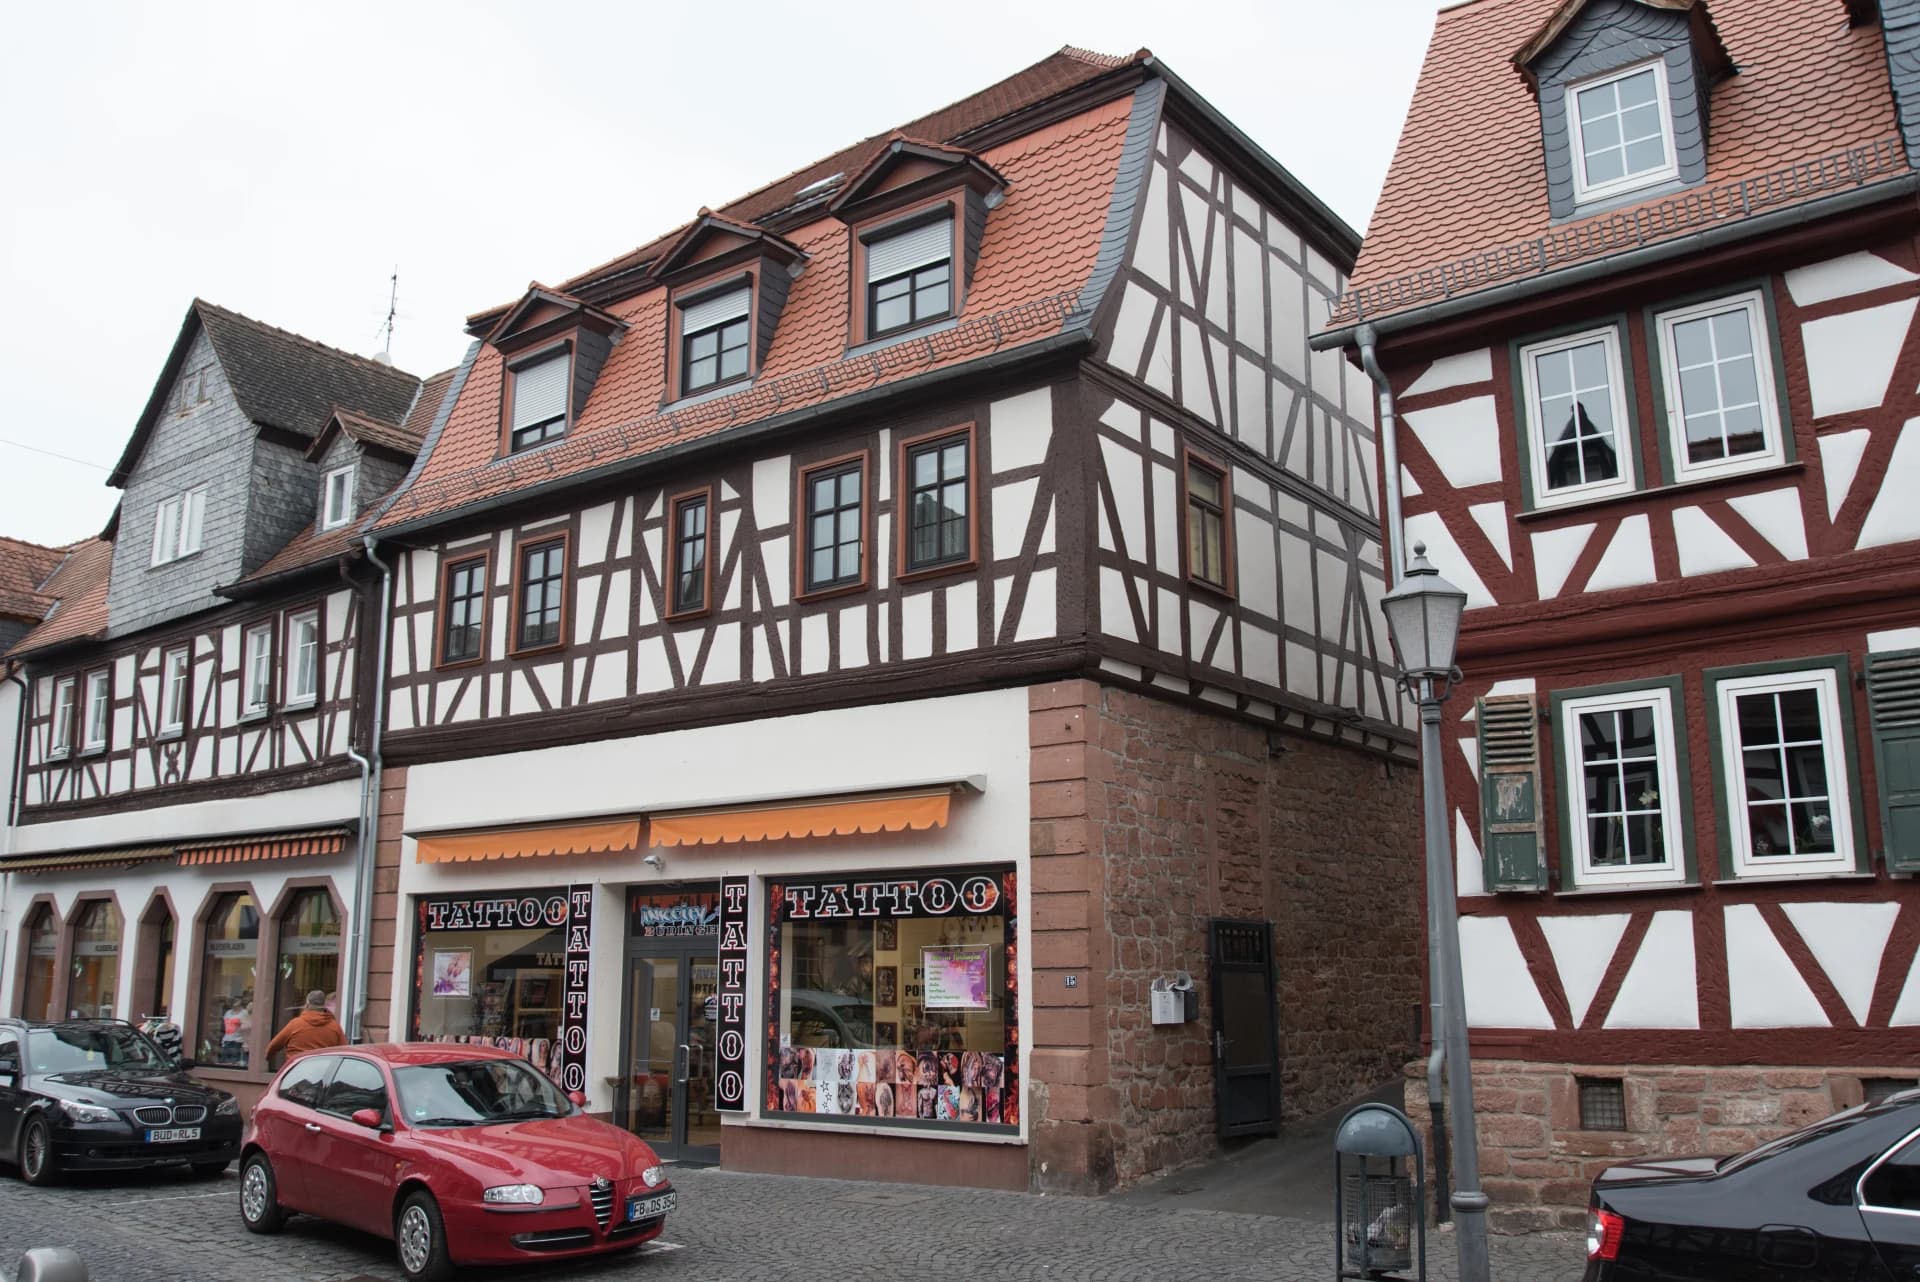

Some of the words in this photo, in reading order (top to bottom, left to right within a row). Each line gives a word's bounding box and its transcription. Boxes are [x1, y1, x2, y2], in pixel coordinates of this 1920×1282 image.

[428, 896, 568, 929] TATTOO
[785, 876, 1000, 918] TATTOO
[563, 891, 591, 1091] TATTOO
[718, 884, 748, 1101] TATTOO
[633, 1202, 645, 1216] FB
[651, 1199, 661, 1212] DS
